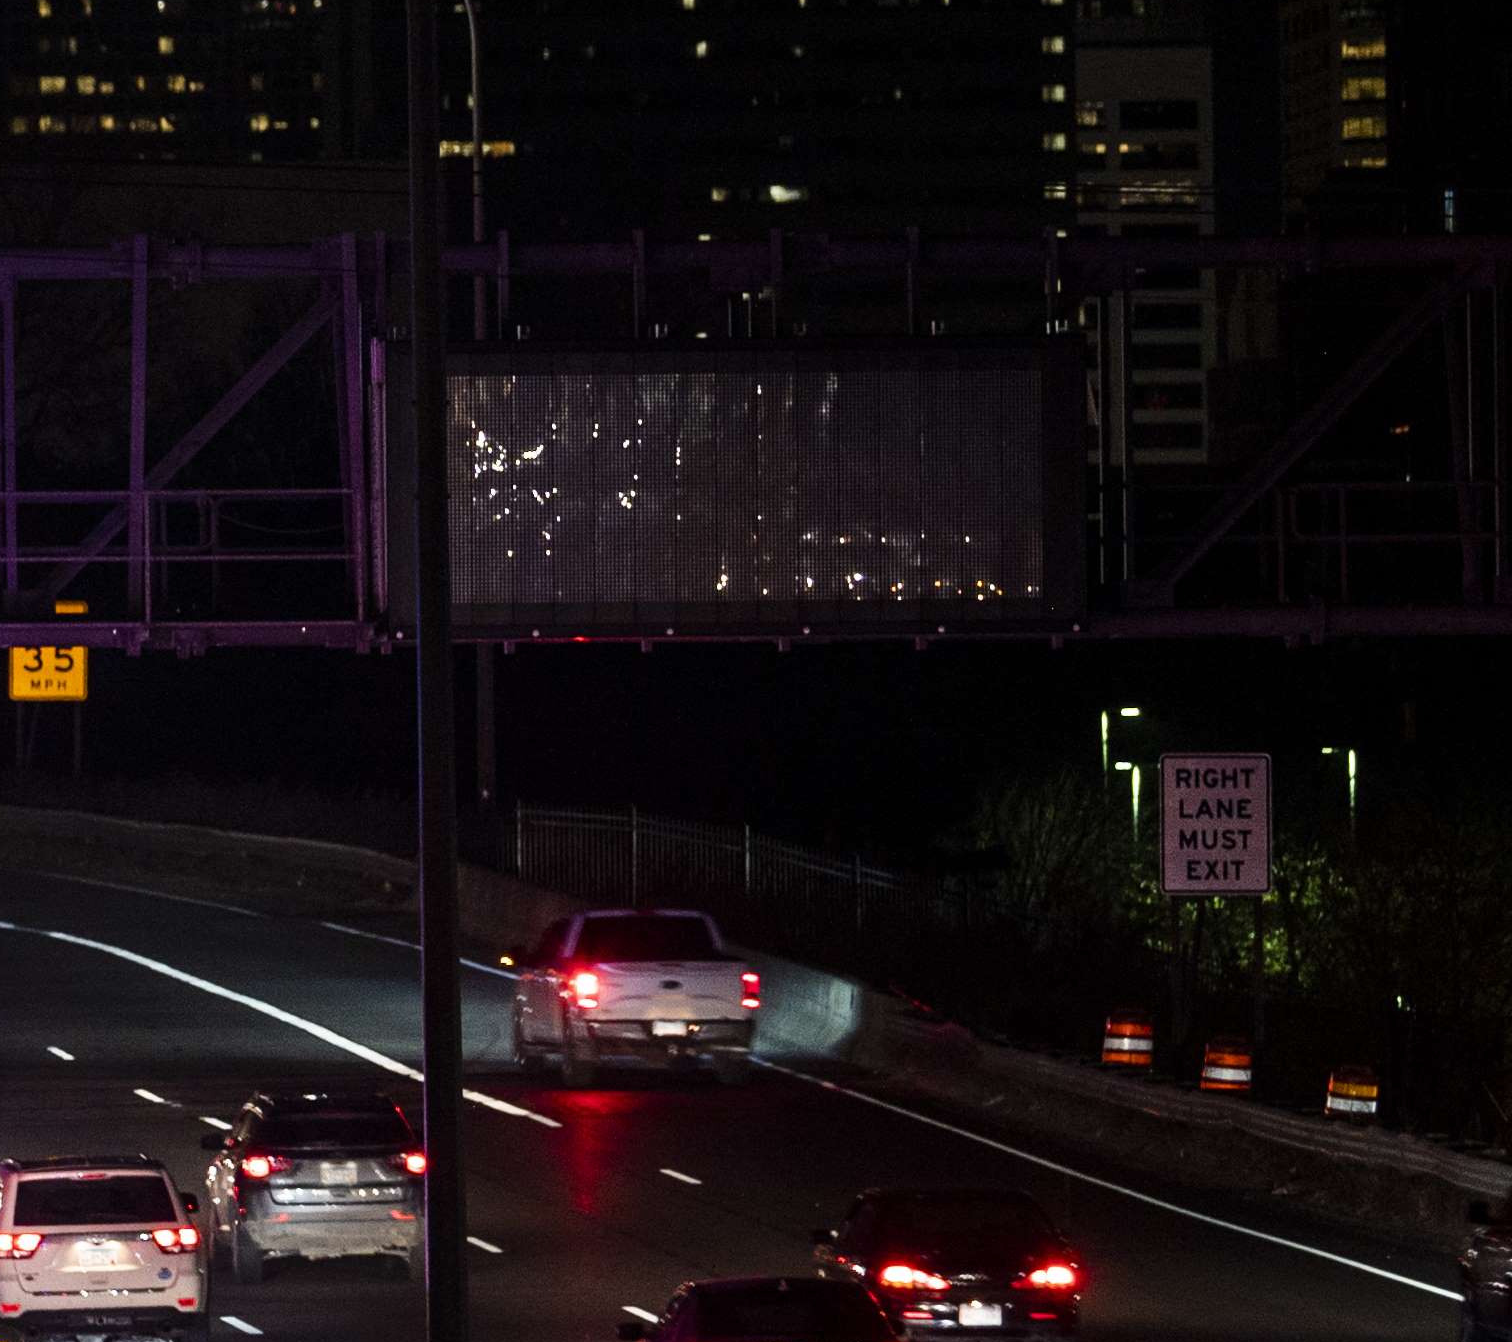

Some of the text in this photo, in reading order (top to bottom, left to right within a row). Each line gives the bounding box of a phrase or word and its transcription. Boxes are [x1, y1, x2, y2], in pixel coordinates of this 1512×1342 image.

[23, 645, 73, 672] 35
[30, 679, 67, 690] MPH
[1175, 768, 1255, 789] RIGHT
[1179, 799, 1252, 819] LANE
[1179, 829, 1252, 850] MUST
[1187, 861, 1245, 881] EXIT
